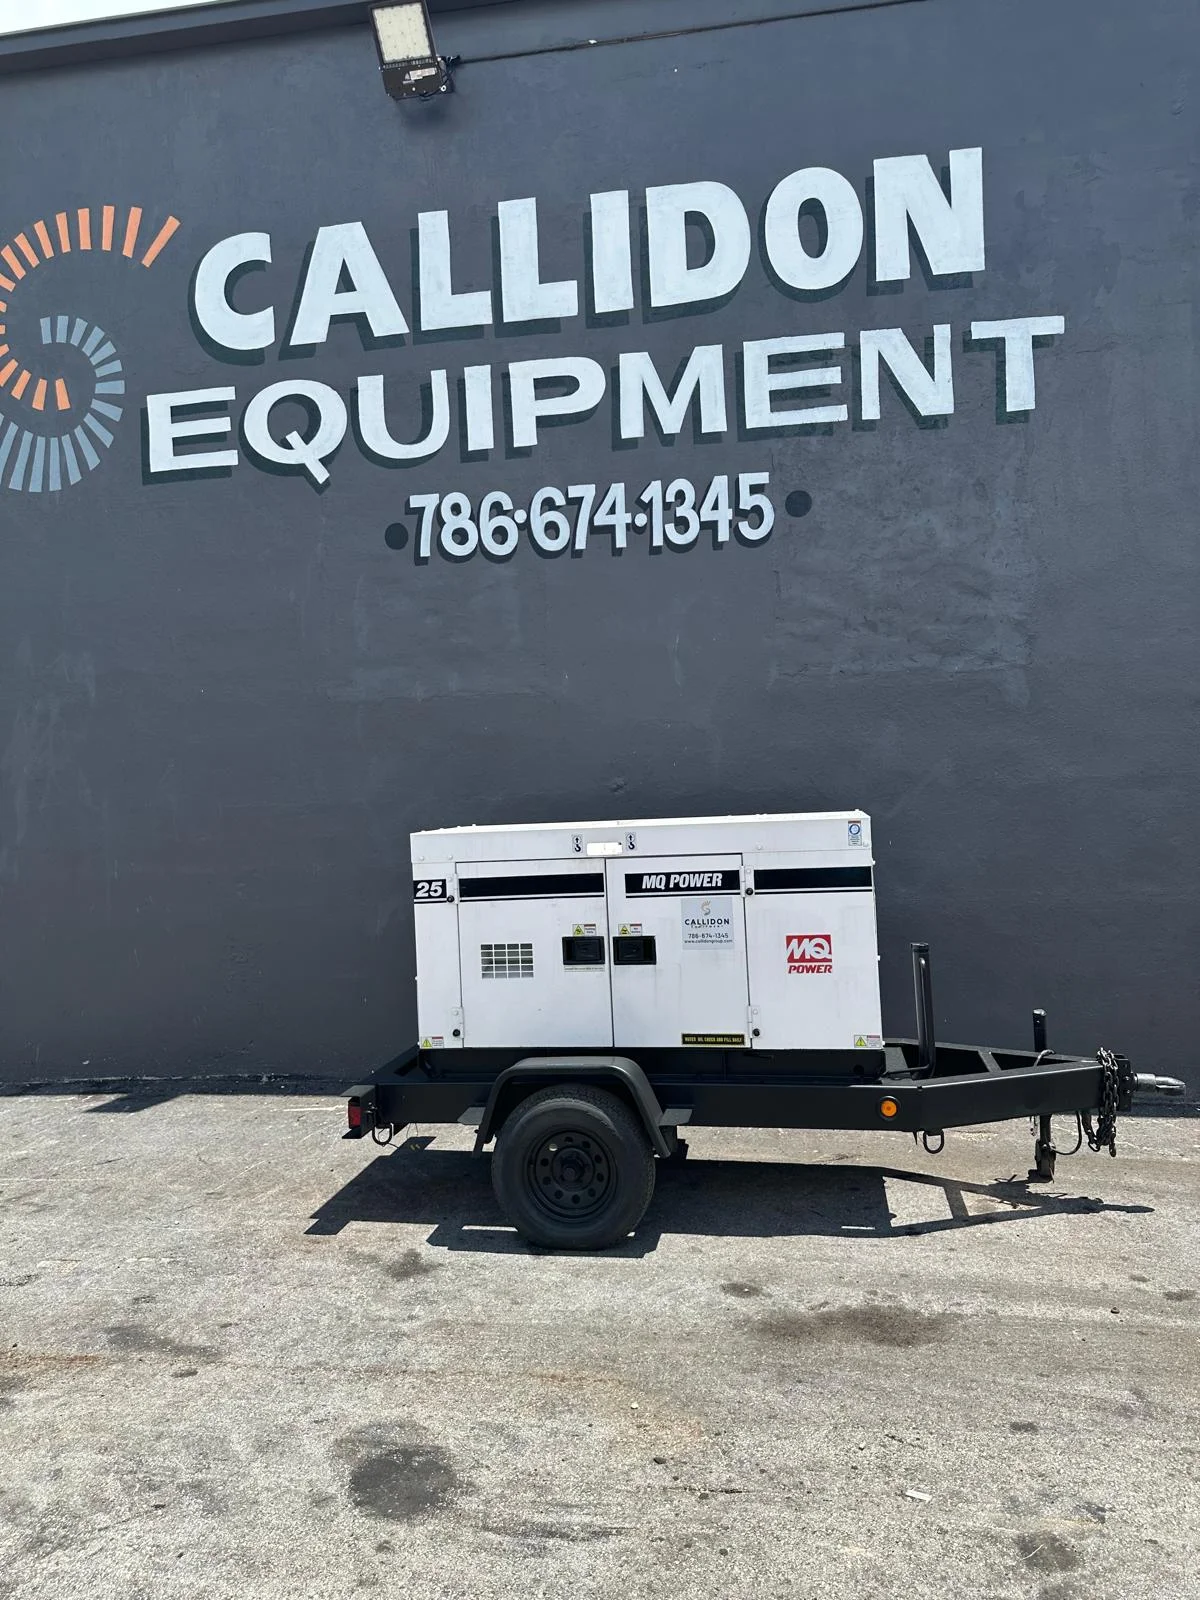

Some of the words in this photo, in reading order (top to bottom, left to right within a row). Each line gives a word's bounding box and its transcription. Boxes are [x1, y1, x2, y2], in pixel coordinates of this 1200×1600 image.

[194, 146, 986, 350] CALLIDON
[146, 315, 1065, 484] EQUIPMENT
[415, 881, 443, 897] 25
[641, 874, 666, 890] MQ
[669, 872, 723, 888] POWER
[684, 918, 730, 926] CALLIDON
[786, 937, 832, 960] MQ
[788, 964, 833, 974] POWER
